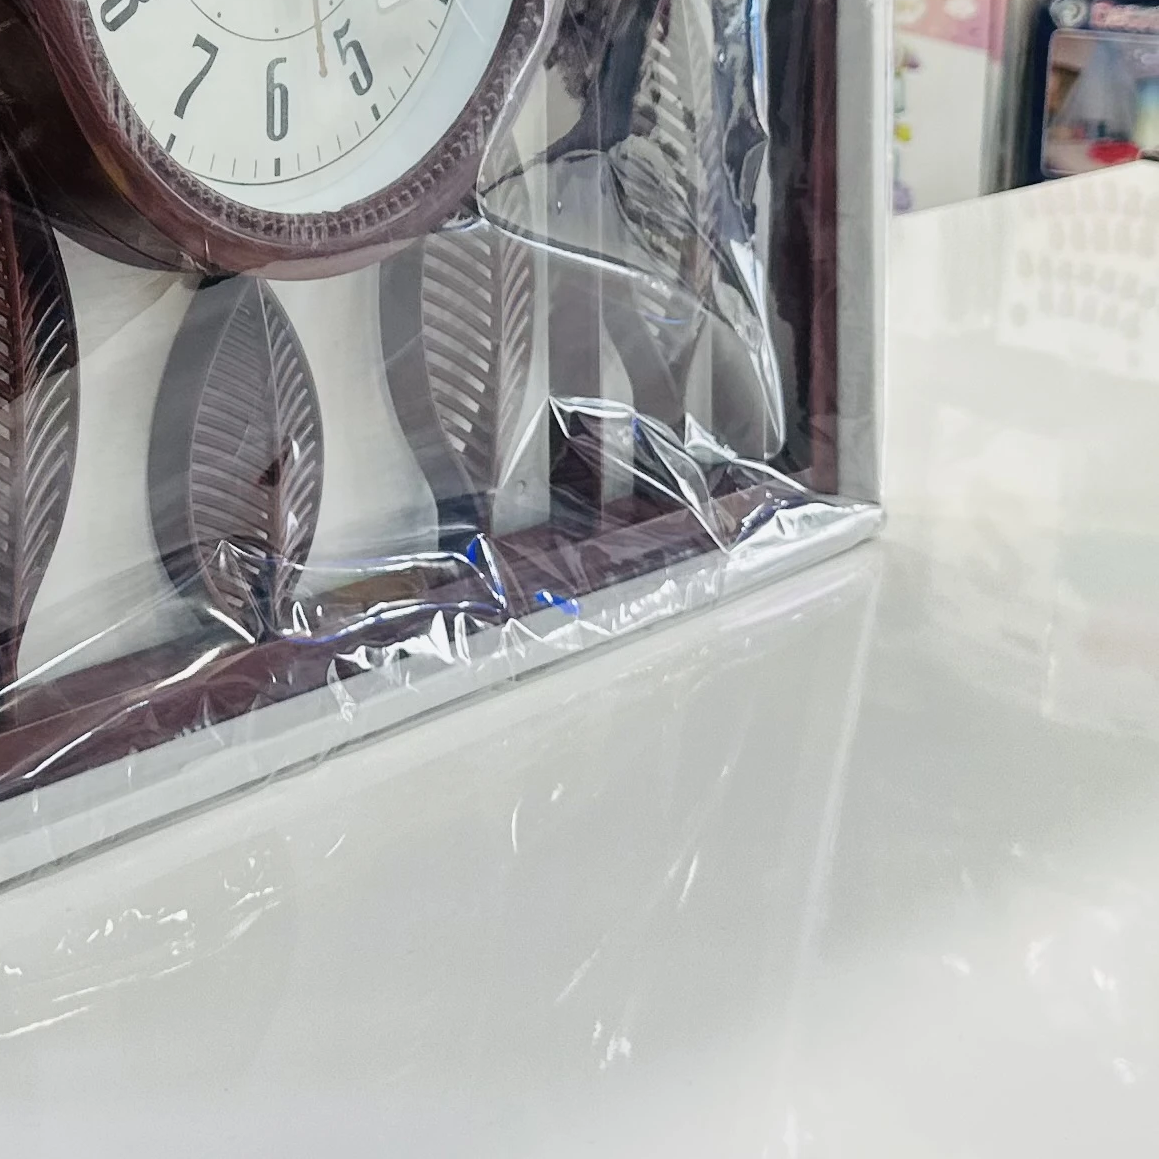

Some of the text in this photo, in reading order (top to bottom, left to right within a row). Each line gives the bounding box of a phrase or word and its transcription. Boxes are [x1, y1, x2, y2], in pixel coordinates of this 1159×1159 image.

[173, 34, 219, 119] 7
[265, 57, 289, 142] 6
[332, 19, 374, 97] 5
